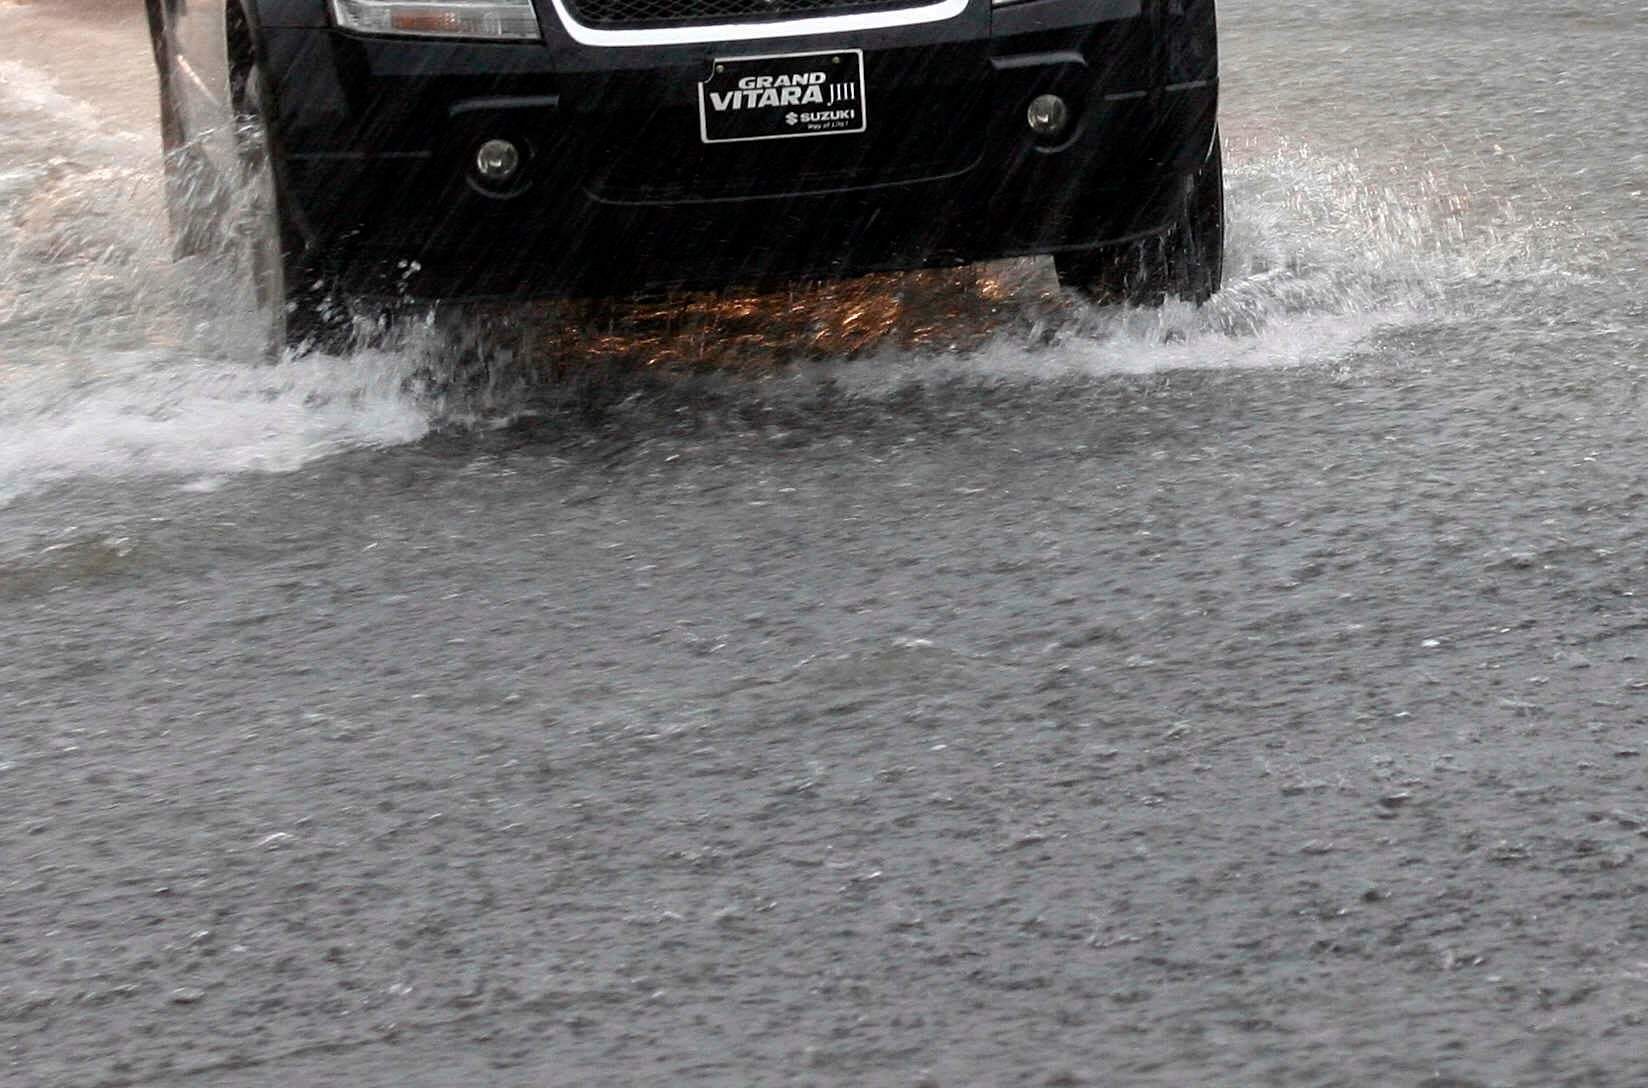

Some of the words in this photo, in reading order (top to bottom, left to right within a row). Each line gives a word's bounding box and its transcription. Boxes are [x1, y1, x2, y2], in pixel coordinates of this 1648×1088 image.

[738, 71, 826, 89] GRAND
[709, 84, 823, 111] VITARA
[827, 82, 856, 106] JIII
[800, 109, 855, 123] SUZUKI
